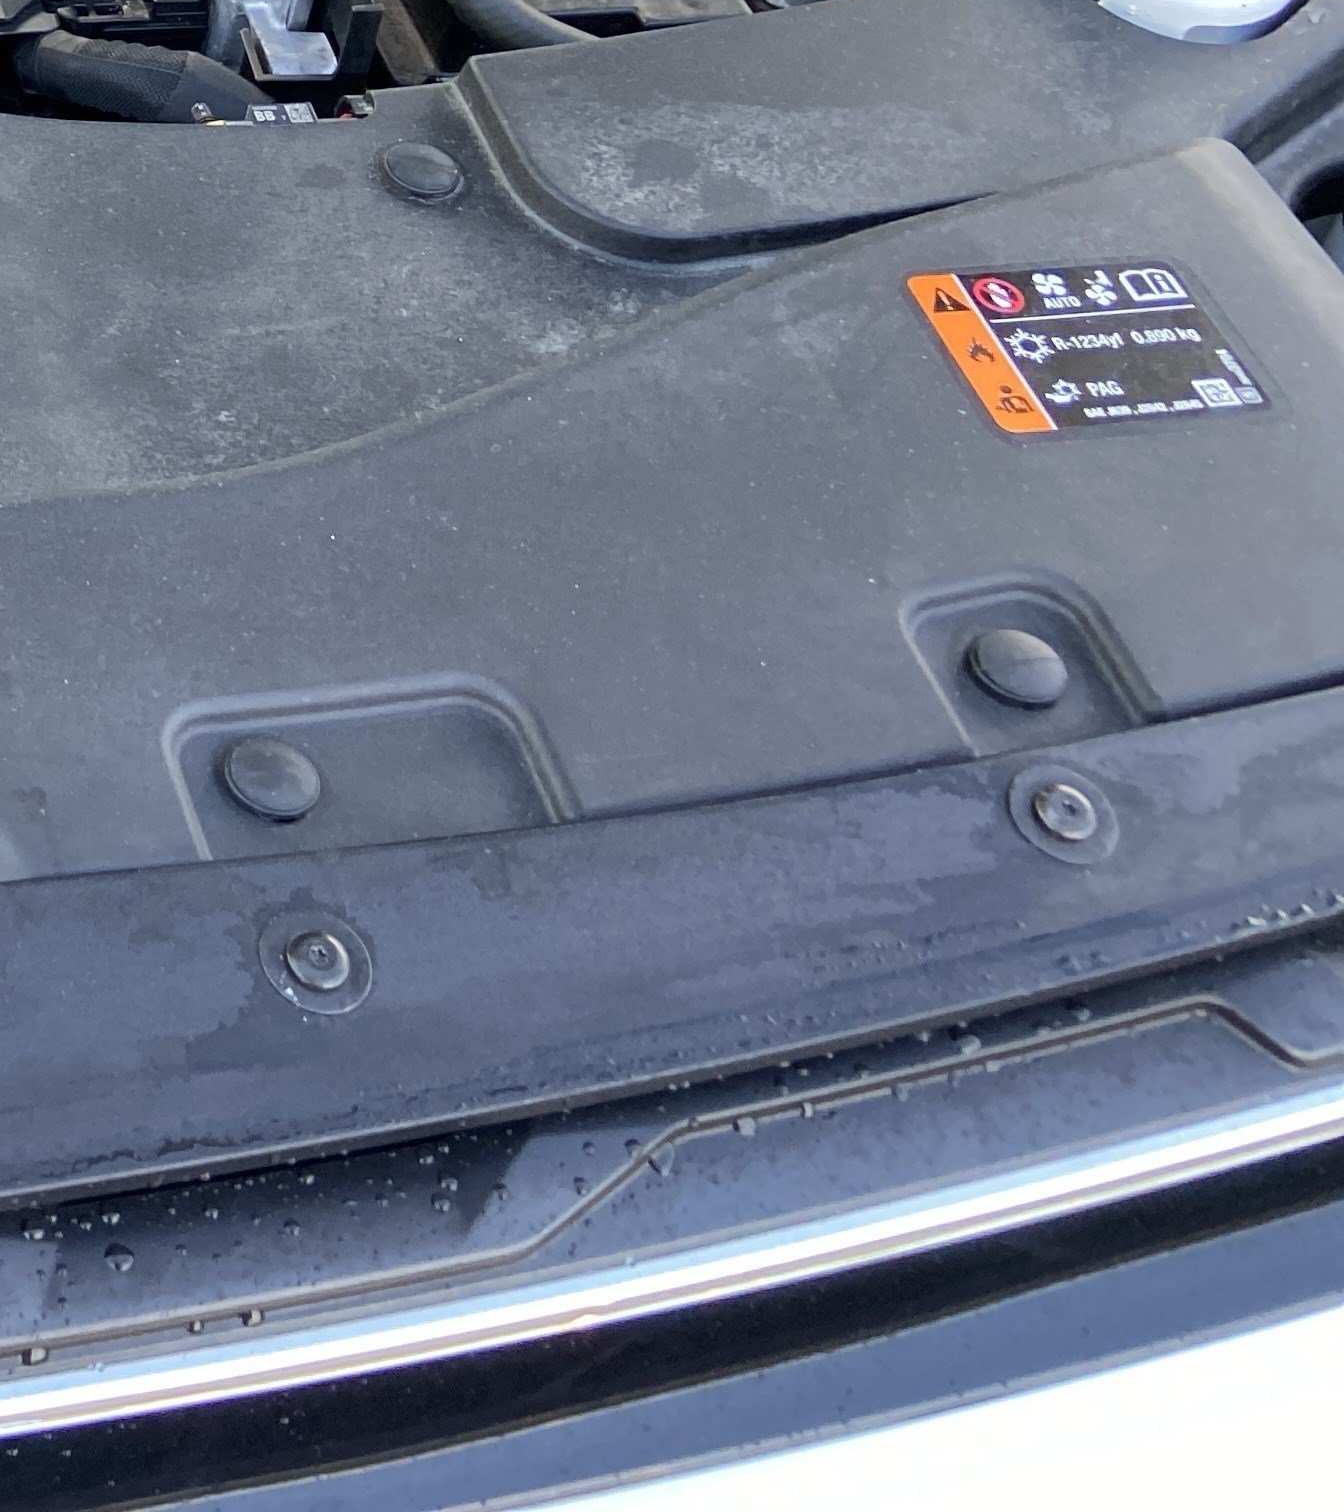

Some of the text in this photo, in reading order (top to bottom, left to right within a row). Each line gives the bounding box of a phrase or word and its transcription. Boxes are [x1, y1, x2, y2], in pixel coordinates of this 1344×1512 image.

[254, 110, 276, 122] BB
[1044, 296, 1082, 309] AUTO
[1051, 332, 1125, 350] R-1234yf
[1176, 327, 1201, 342] kg
[1086, 381, 1124, 397] PAG
